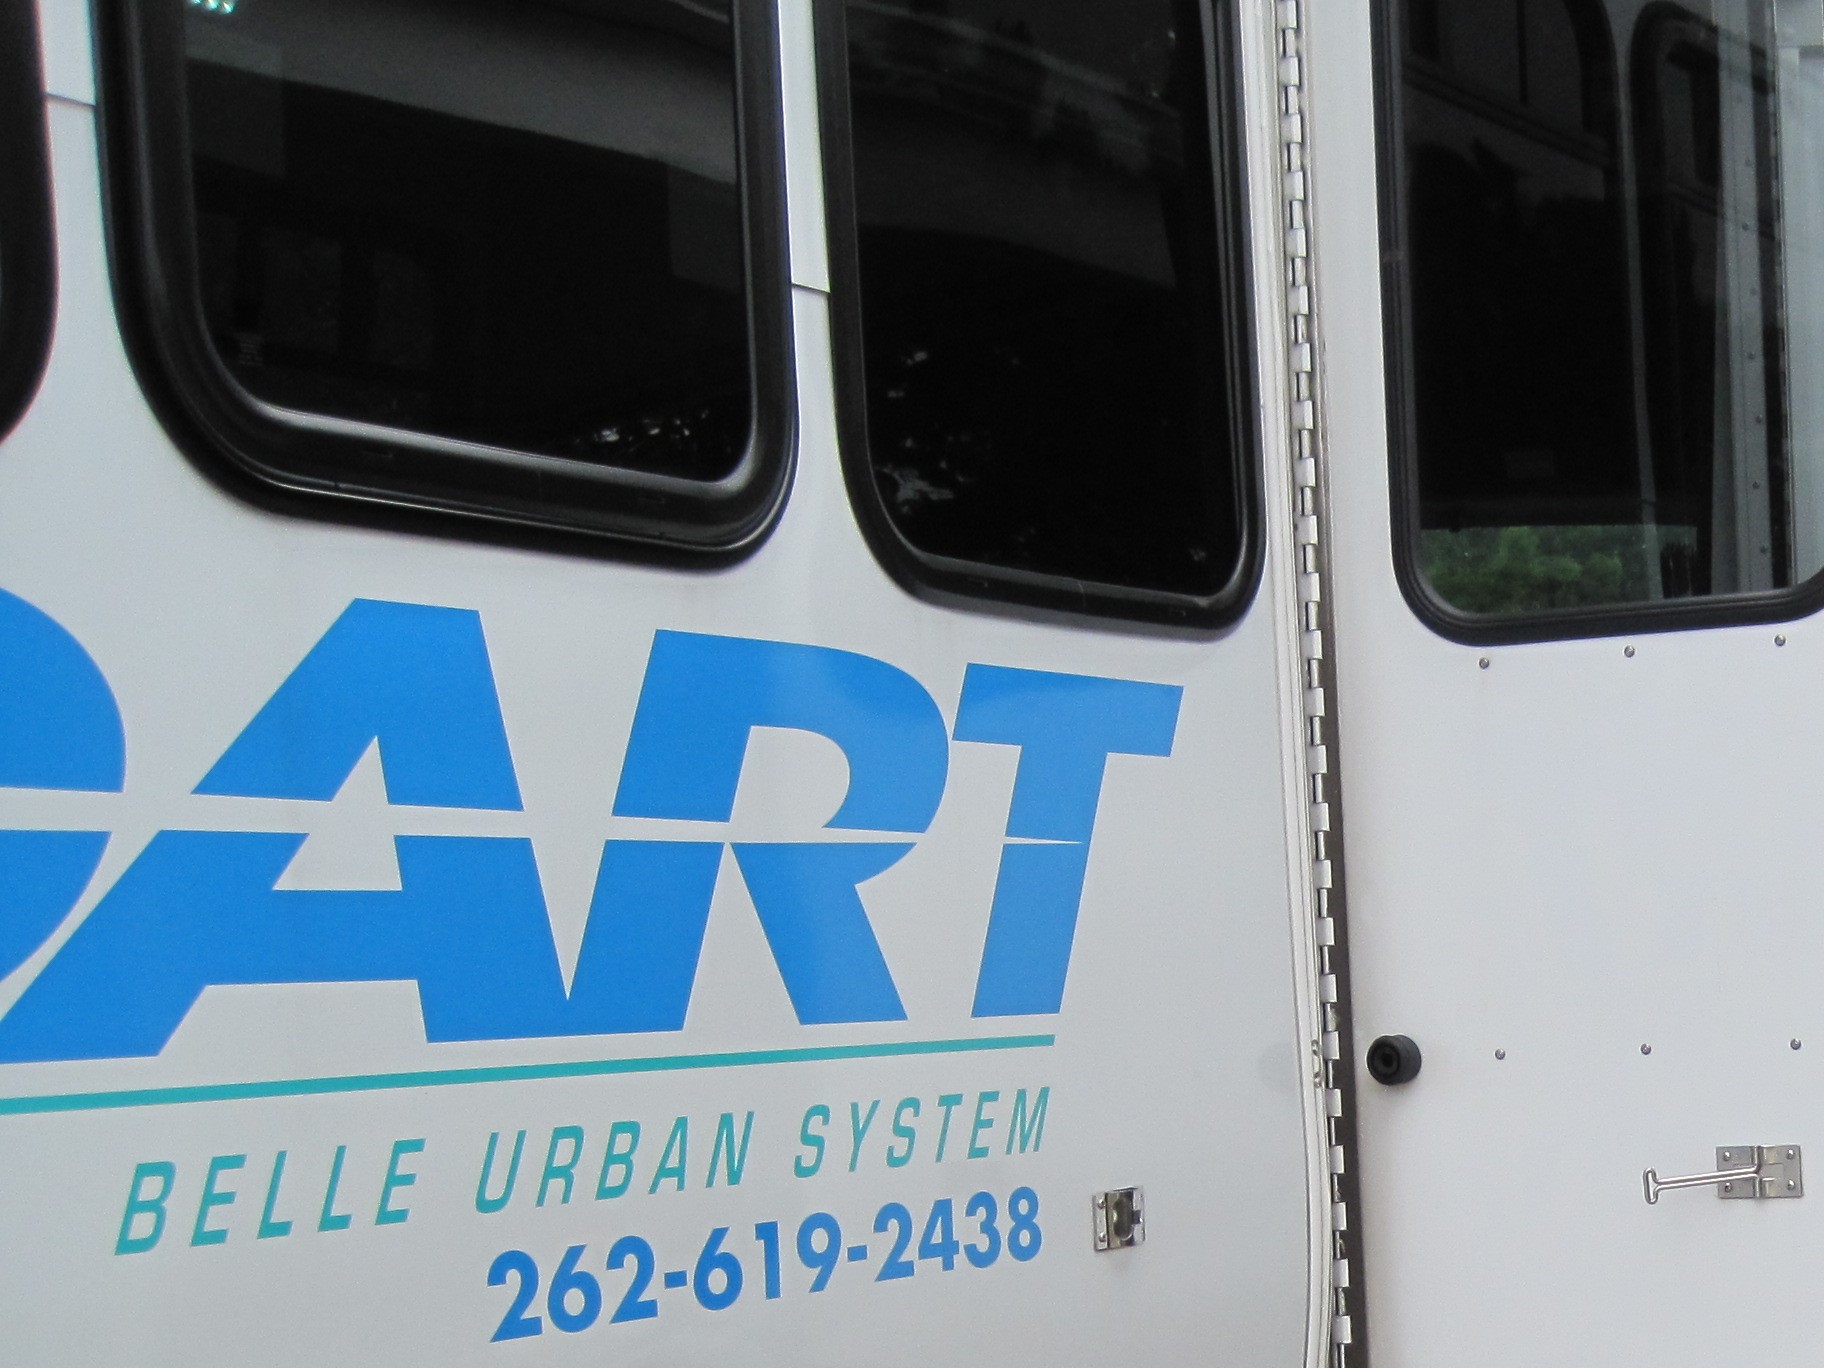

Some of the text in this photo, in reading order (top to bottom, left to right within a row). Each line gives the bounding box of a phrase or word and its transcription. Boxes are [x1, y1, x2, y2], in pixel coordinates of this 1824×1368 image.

[115, 1086, 1051, 1256] BELLE URBAN SYSTEM
[487, 1186, 1043, 1343] 262-619-2438
